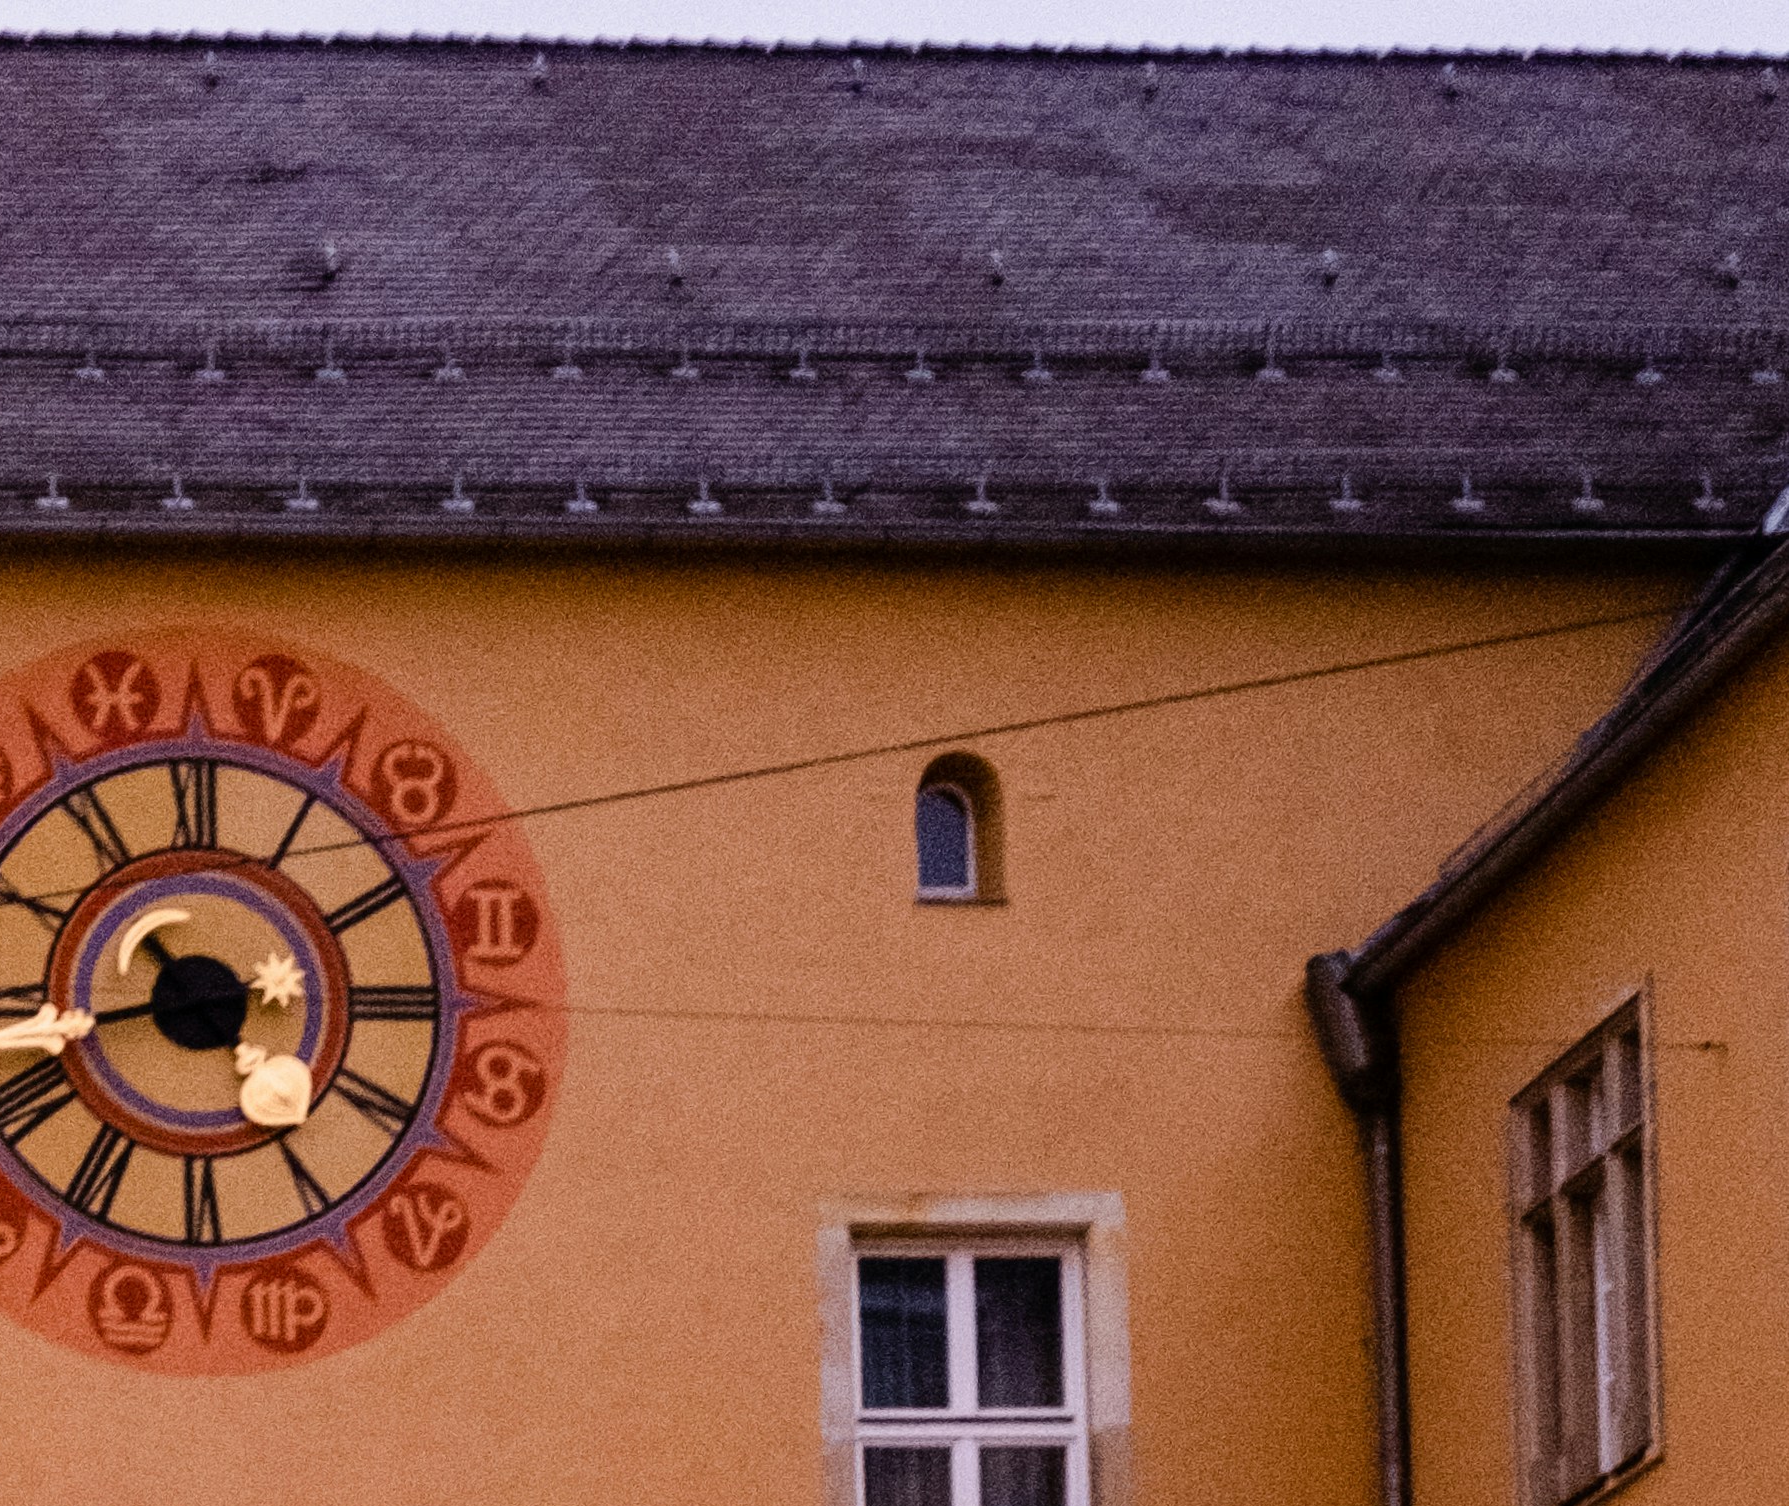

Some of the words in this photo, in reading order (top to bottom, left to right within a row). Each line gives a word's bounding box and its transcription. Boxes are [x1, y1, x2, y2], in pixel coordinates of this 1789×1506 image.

[60, 787, 130, 866] XI
[169, 761, 219, 849] XII
[324, 873, 407, 934] II
[350, 987, 436, 1021] III
[69, 1124, 136, 1218] VII
[184, 1156, 222, 1243] VI
